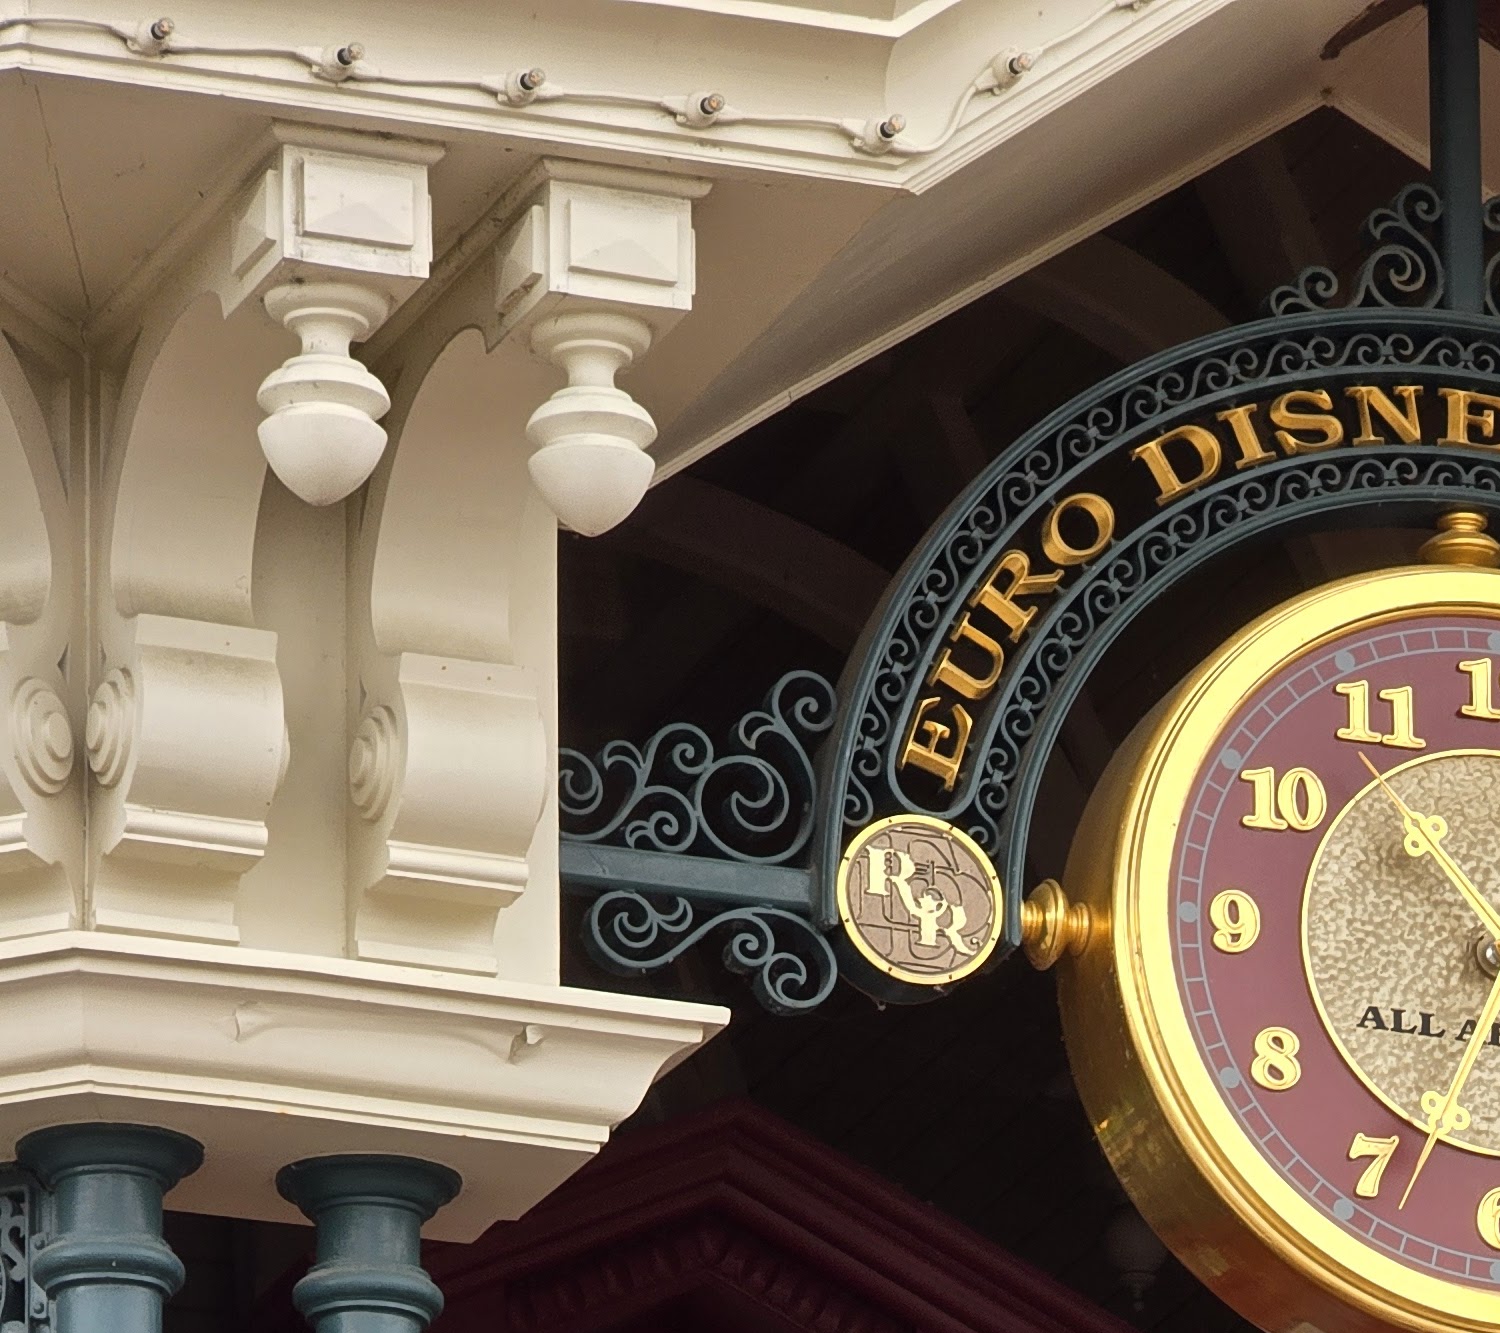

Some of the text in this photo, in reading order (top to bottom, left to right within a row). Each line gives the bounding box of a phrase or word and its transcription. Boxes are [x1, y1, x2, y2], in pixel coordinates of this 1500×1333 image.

[901, 491, 1116, 791] EURO
[1336, 680, 1426, 749] 11
[1241, 767, 1327, 831] 10
[1210, 889, 1261, 952] 9
[1357, 1005, 1446, 1040] ALL
[1250, 1027, 1301, 1090] 8
[1349, 1134, 1399, 1197] 7
